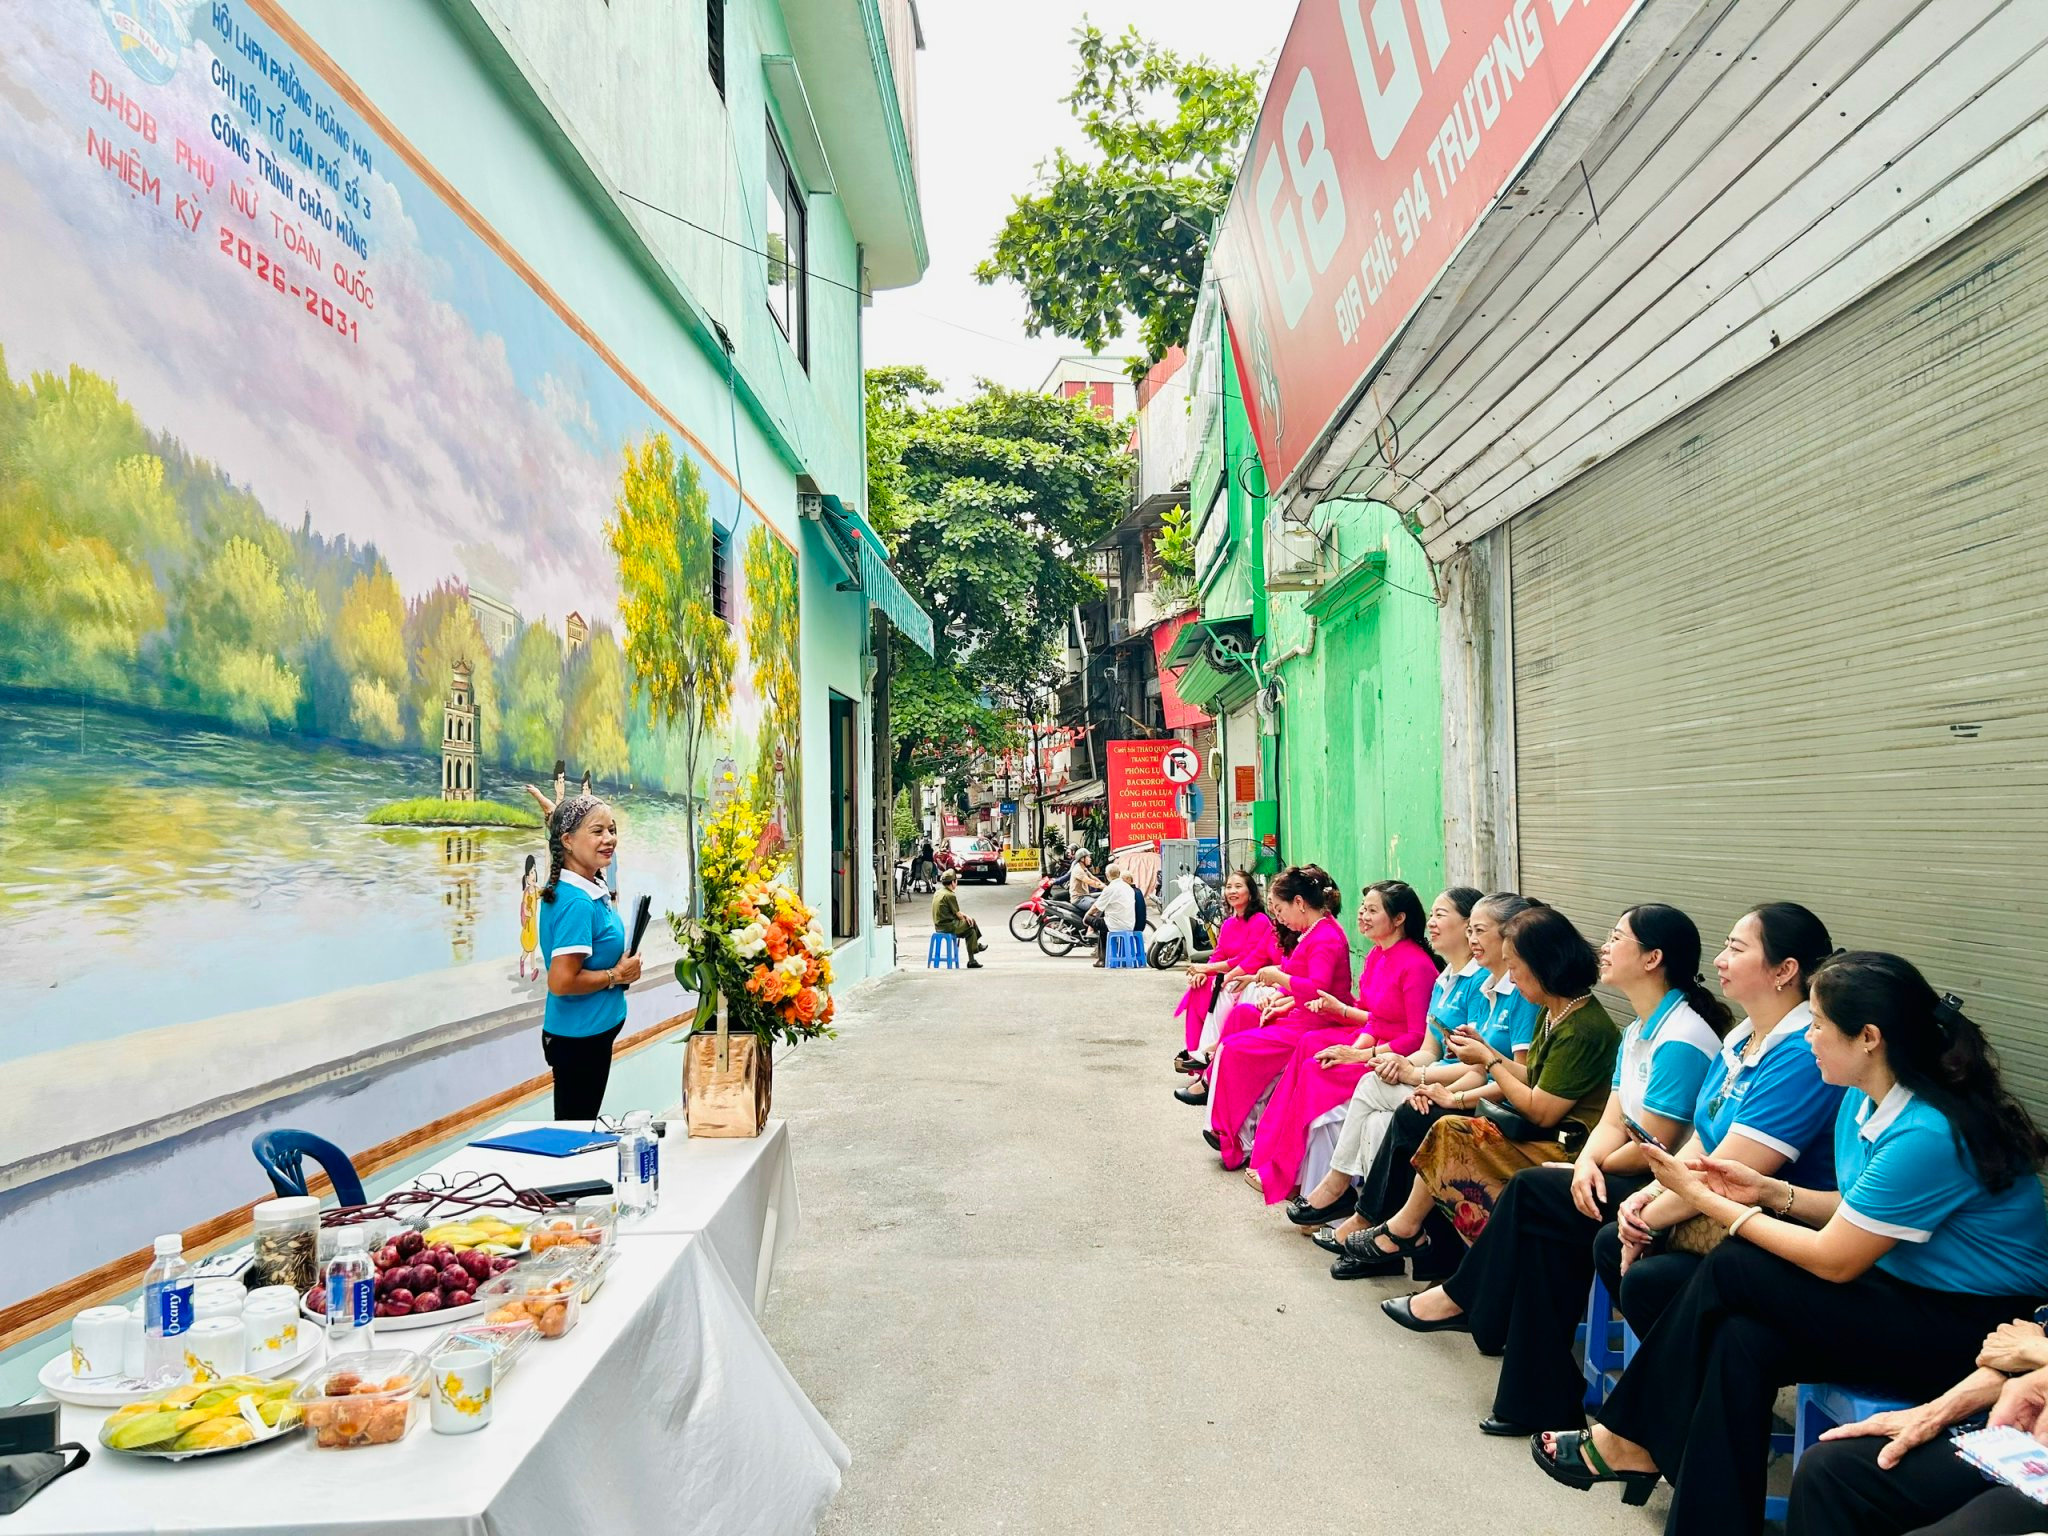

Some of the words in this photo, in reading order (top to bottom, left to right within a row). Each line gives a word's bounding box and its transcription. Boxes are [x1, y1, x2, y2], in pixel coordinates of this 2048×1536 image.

[211, 59, 235, 101] CHI
[239, 82, 261, 126] HỘI
[266, 103, 286, 143] TỔ
[289, 127, 313, 170] DÂN
[317, 154, 340, 191] PHỐ
[345, 176, 359, 209] SỐ
[363, 197, 371, 220] 3
[212, 2, 232, 44] HỘI
[235, 25, 267, 76] LHPN
[270, 58, 312, 117] PHƯỜNG
[315, 102, 350, 153] HOÀNG
[353, 139, 372, 174] MAI
[87, 126, 161, 206] NHIỆM
[175, 192, 203, 232] KỲ
[220, 226, 358, 344] 2026-2031
[89, 69, 157, 144] ĐHĐB
[175, 137, 214, 194] PHỤ
[270, 210, 321, 271] TOÀN
[333, 262, 374, 310] QUỐC
[211, 113, 250, 164] CÔNG
[255, 148, 293, 201] TRÌNH
[299, 187, 332, 231] CHÀO
[336, 211, 367, 261] MỪNG
[1256, 66, 1346, 330] G8
[1334, 274, 1366, 347] ĐỊA
[1360, 209, 1398, 307] CHỈ:
[1393, 167, 1432, 258] 914
[1426, 0, 1544, 199] TRƯƠNG
[1126, 778, 1165, 786] BACKDROP
[1128, 833, 1146, 841] SINH
[1131, 800, 1147, 808] HOA
[168, 1292, 182, 1335] Ocany
[360, 1282, 371, 1325] Ocany
